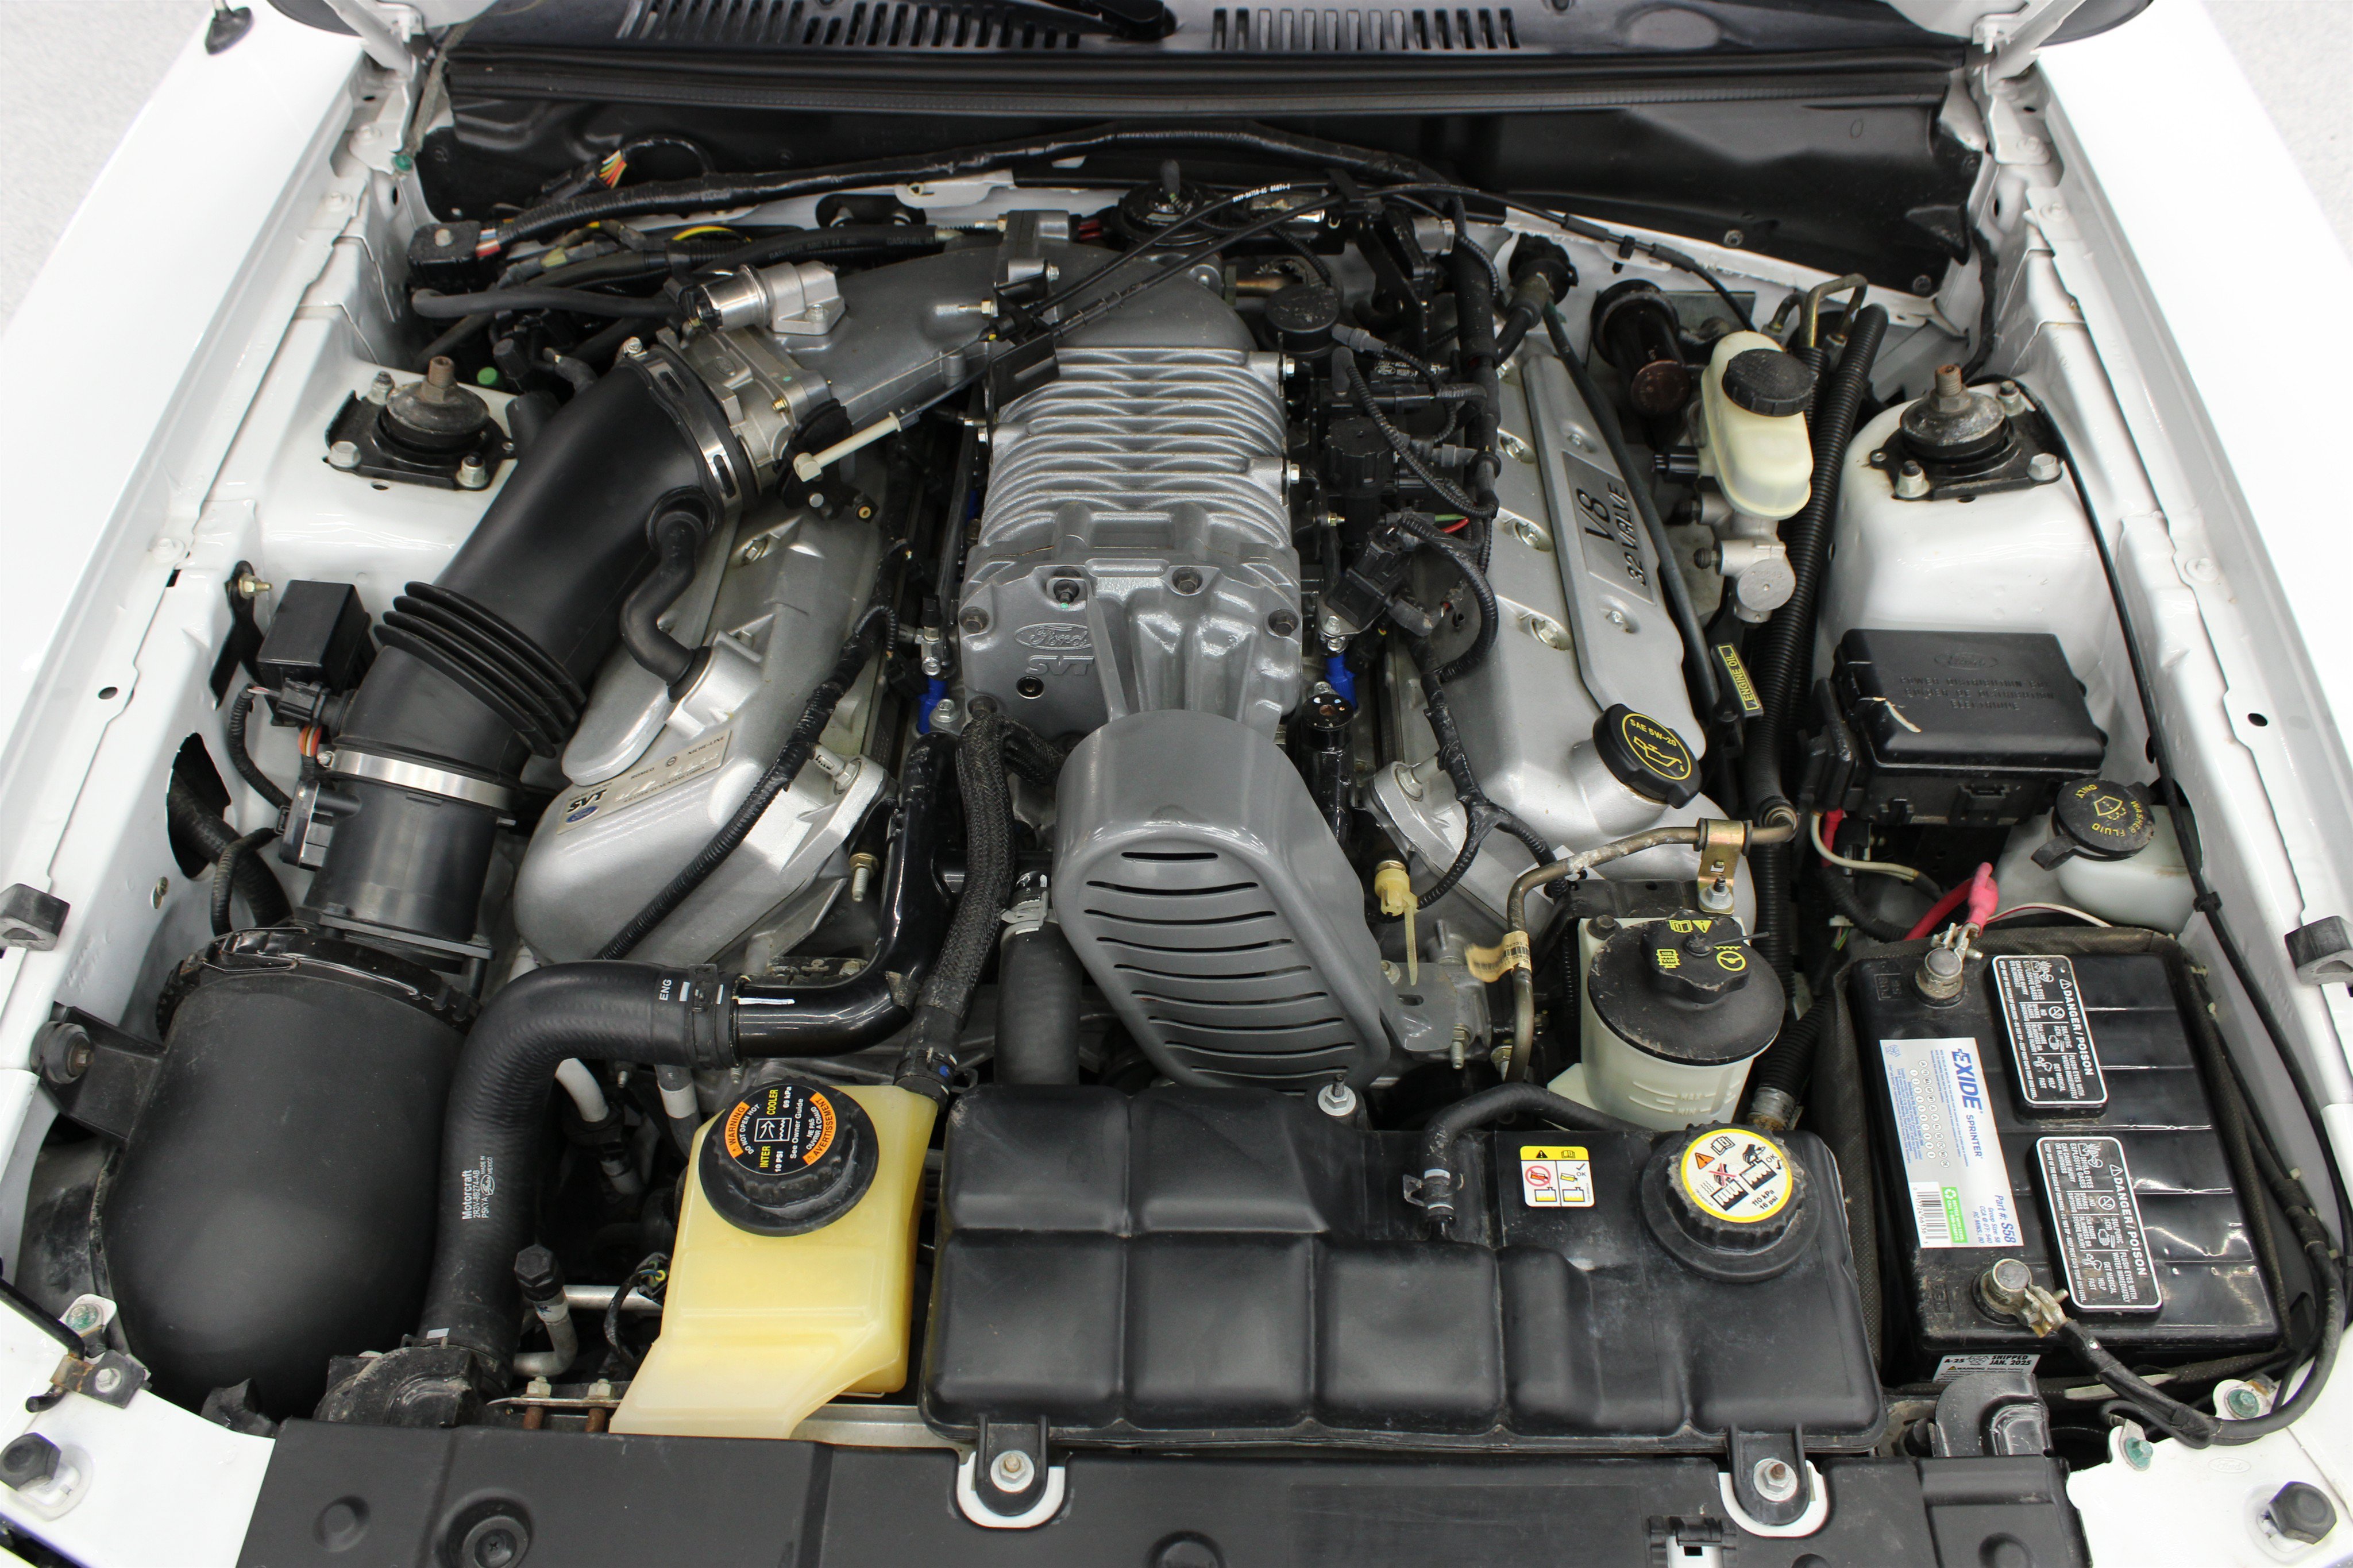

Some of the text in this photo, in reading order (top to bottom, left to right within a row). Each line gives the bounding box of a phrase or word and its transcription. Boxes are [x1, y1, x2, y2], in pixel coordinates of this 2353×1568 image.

[1576, 488, 1615, 542] V8
[1607, 481, 1646, 586] 32 VALVE
[1029, 625, 1088, 646] Ford
[1025, 655, 1094, 676] SVT
[1725, 652, 1753, 701] ENGINE OIL
[1629, 719, 1677, 747] SAE 5W-20
[566, 789, 607, 813] SVT
[2075, 784, 2144, 837] WASHER FLUID ONLY
[659, 979, 672, 1001] ENG
[2022, 960, 2039, 1000] EXPLOSIVE GASES
[2031, 972, 2045, 1000] SHIELD EYES
[2053, 1025, 2062, 1036] ACID
[2060, 1025, 2073, 1048] SULFURIC
[2062, 990, 2082, 1030] DANGER
[2074, 1036, 2094, 1075] POISON
[1950, 1048, 1982, 1110] EXIDE
[2037, 1077, 2047, 1088] FAST
[2046, 1077, 2056, 1088] HELP
[2052, 1063, 2066, 1091] GET MEDICAL
[2060, 1055, 2078, 1099] WATER IMMEDIATELY
[2067, 1055, 2085, 1096] FLUSH EYES WITH
[728, 1106, 746, 1146] WARNING
[739, 1103, 761, 1154] DO NOT OPEN HOT
[759, 1089, 778, 1168] INTER COOLER
[774, 1086, 792, 1172] 10 PSI 69 kPa
[790, 1098, 804, 1159] See Owner Guide
[811, 1106, 823, 1124] CHAUD
[813, 1098, 833, 1156] AVERTISSEMENT
[806, 1130, 821, 1150] OUVRIR
[1965, 1114, 1982, 1157] SPRINTER
[1765, 1153, 1778, 1163] OK
[2055, 1149, 2067, 1173] BLINDNESS
[2060, 1142, 2076, 1183] CAN CAUSE INJURY
[2069, 1142, 2086, 1188] EXPLOSIVE GASES
[2079, 1156, 2094, 1188] SHIELD EYES
[461, 1169, 473, 1220] Motorcraft
[1752, 1189, 1775, 1206] 110 kPa
[1759, 1196, 1779, 1210] 16 psi
[1994, 1195, 2007, 1211] Part
[2066, 1192, 2077, 1212] SMOKING
[2073, 1192, 2083, 1209] FLAMES
[2079, 1192, 2089, 1209] SPARKS
[1978, 1206, 1986, 1216] CCA
[1985, 1234, 1993, 1243] 540
[1986, 1207, 1996, 1222] Group
[1991, 1223, 1999, 1235] Size:
[2000, 1222, 2018, 1243] S58
[2072, 1215, 2086, 1249] SEVERE INJURY
[2078, 1216, 2090, 1239] BLINDNESS
[2085, 1216, 2097, 1239] CAN CAUSE
[2103, 1217, 2113, 1230] ACID
[2110, 1218, 2124, 1243] SULFURIC
[2112, 1177, 2134, 1223] DANGER
[2126, 1231, 2147, 1275] POISON
[2086, 1277, 2097, 1290] FAST
[2096, 1277, 2107, 1291] HELP
[2102, 1261, 2117, 1294] GET MEDICAL
[2111, 1252, 2131, 1303] WATER IMMEDIATELY
[2119, 1252, 2138, 1299] FLUSH EYES WITH
